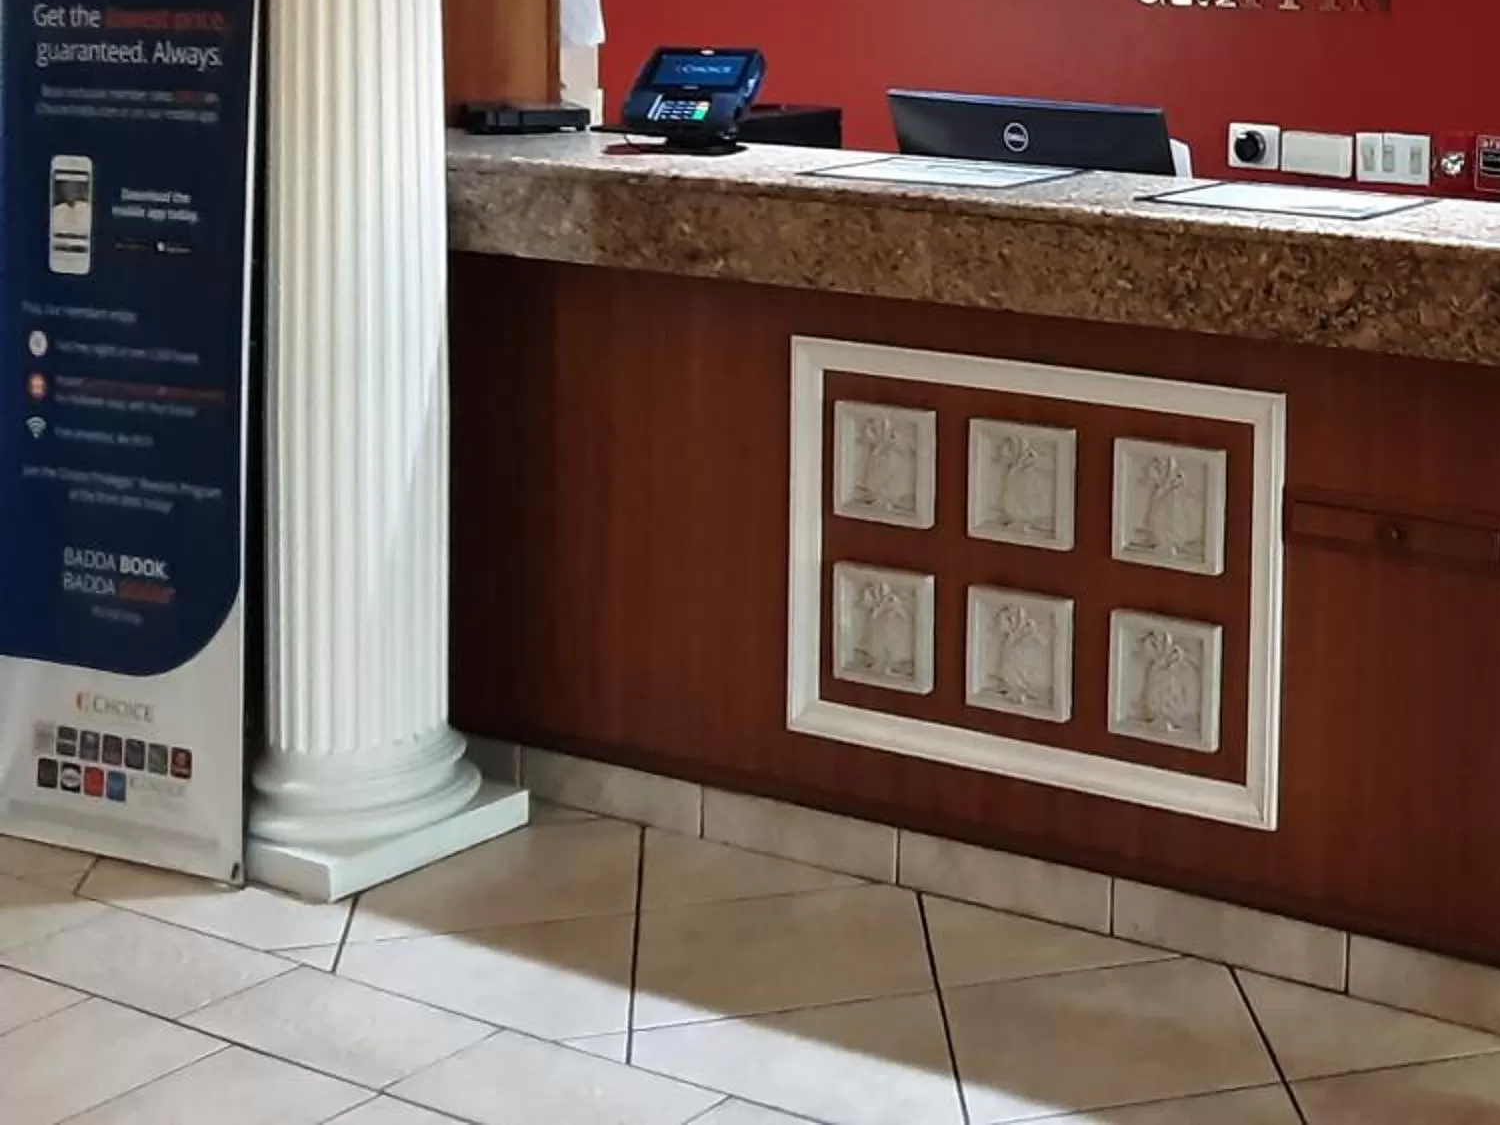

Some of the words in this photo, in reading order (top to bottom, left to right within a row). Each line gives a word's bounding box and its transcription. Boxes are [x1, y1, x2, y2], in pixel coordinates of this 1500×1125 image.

[33, 3, 68, 28] Get
[70, 4, 101, 29] the
[36, 39, 148, 67] guaranteed.
[152, 40, 224, 71] Always.
[63, 546, 117, 572] BADDA
[63, 571, 117, 595] BADDA
